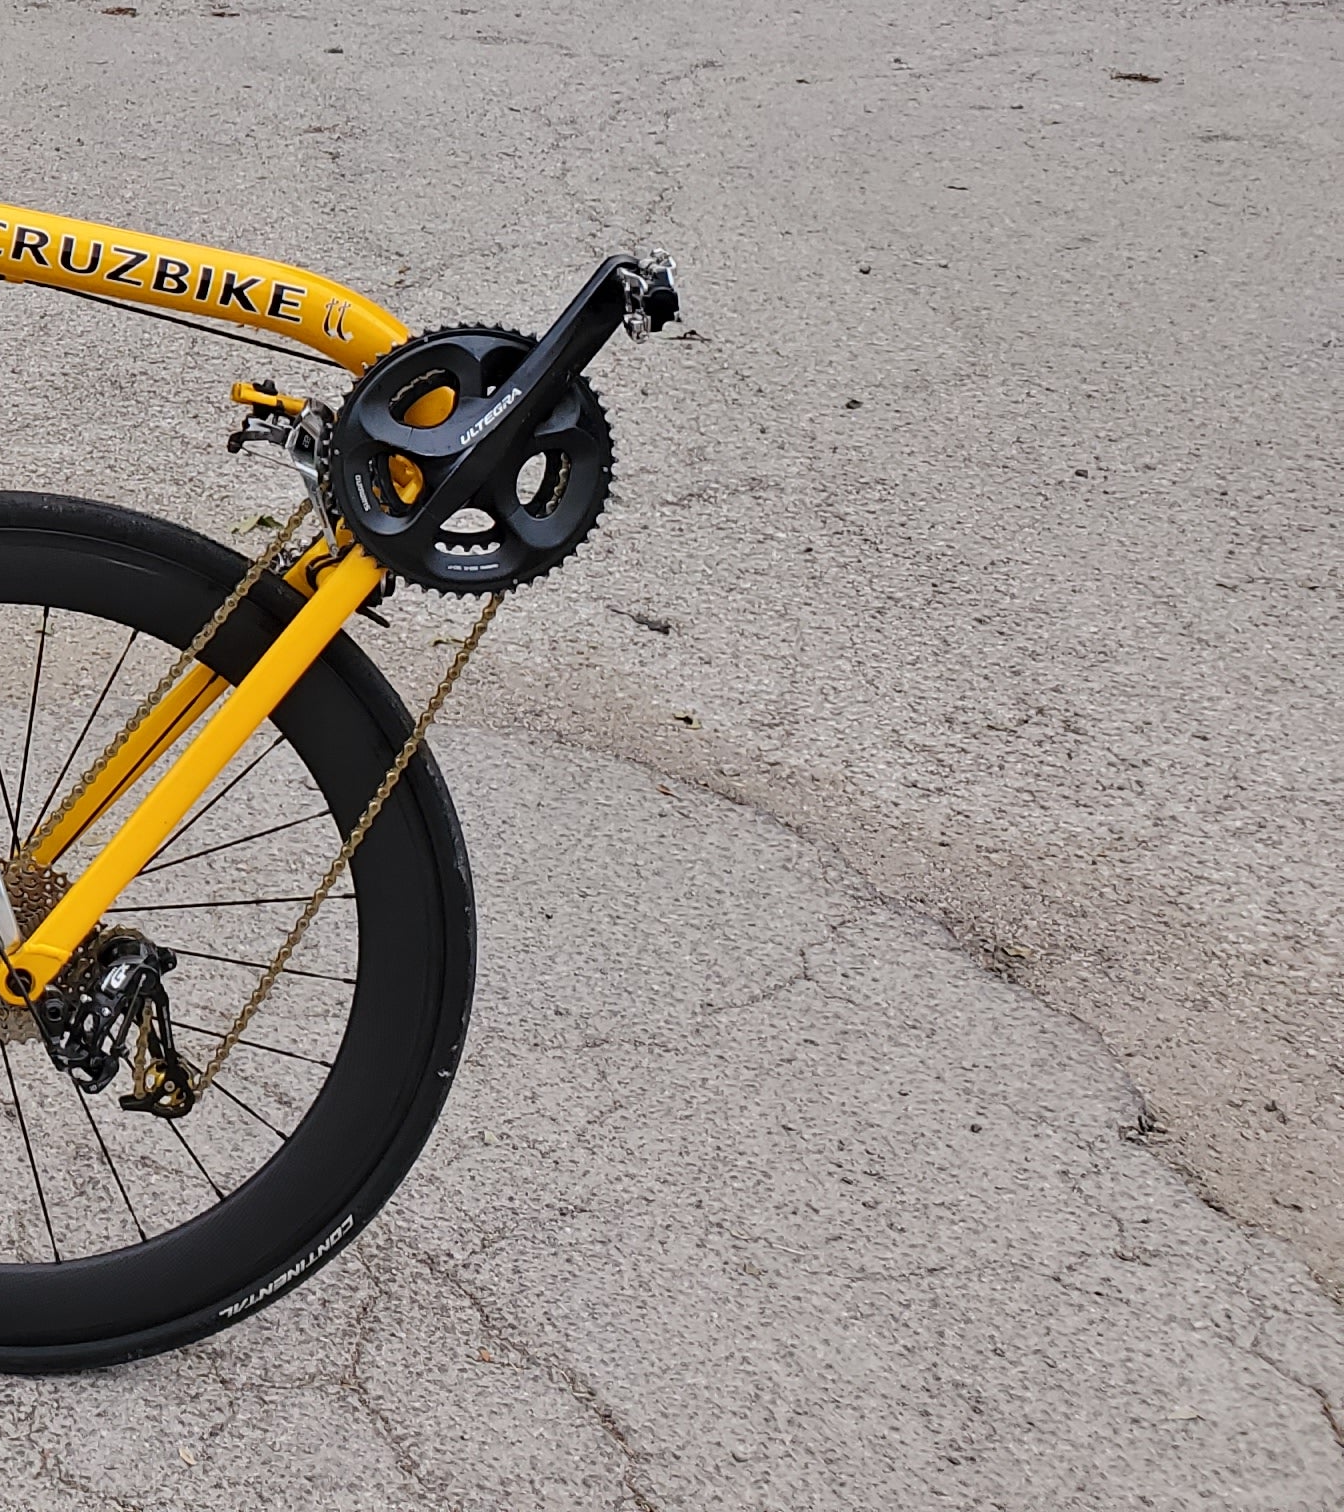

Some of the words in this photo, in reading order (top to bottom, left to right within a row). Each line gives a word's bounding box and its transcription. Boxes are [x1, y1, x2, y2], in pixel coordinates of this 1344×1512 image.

[460, 387, 523, 446] ULTEGRA
[354, 474, 371, 512] SHIMANO
[218, 1214, 354, 1319] CONTINENTAL
